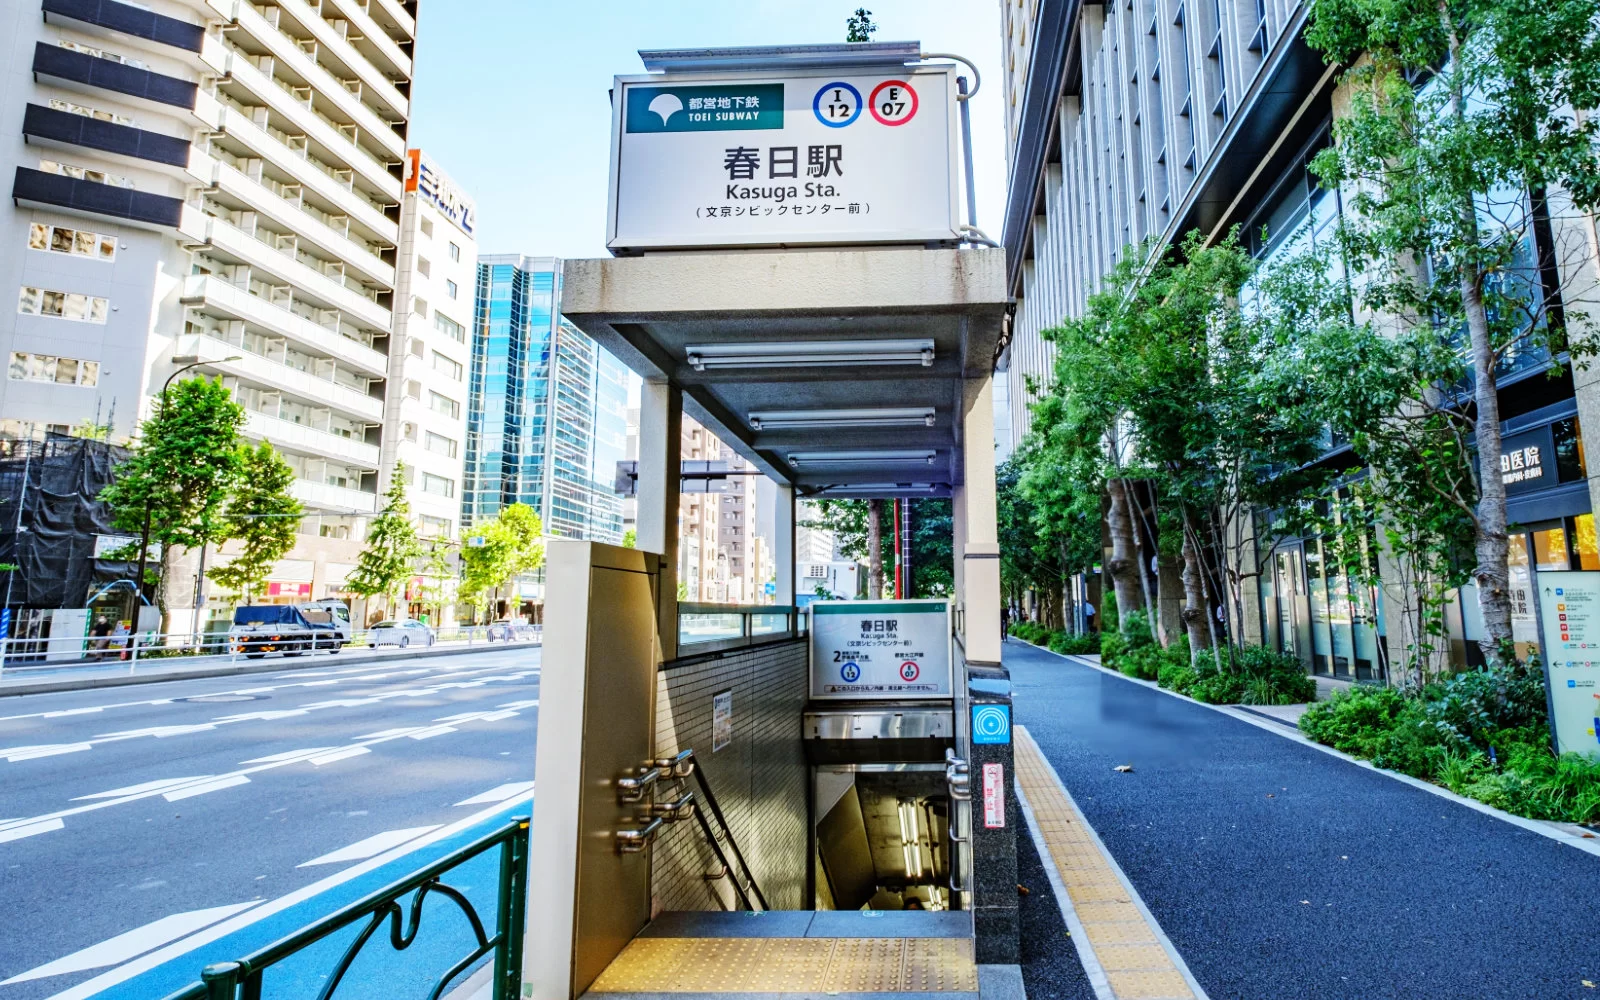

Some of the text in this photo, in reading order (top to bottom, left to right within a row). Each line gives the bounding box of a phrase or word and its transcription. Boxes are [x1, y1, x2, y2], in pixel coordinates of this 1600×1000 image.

[834, 90, 842, 102] I
[890, 88, 898, 100] E
[688, 95, 760, 110] 都営地下鉄
[828, 104, 849, 117] 12
[881, 103, 906, 116] 07
[688, 111, 760, 122] TOEI SUBWAY
[723, 144, 843, 181] 春日駅
[726, 182, 841, 203] Kasuga Sta.
[696, 202, 870, 218] （文京シビックセンター前）
[860, 619, 898, 632] 春日駅
[833, 650, 841, 662] 2
